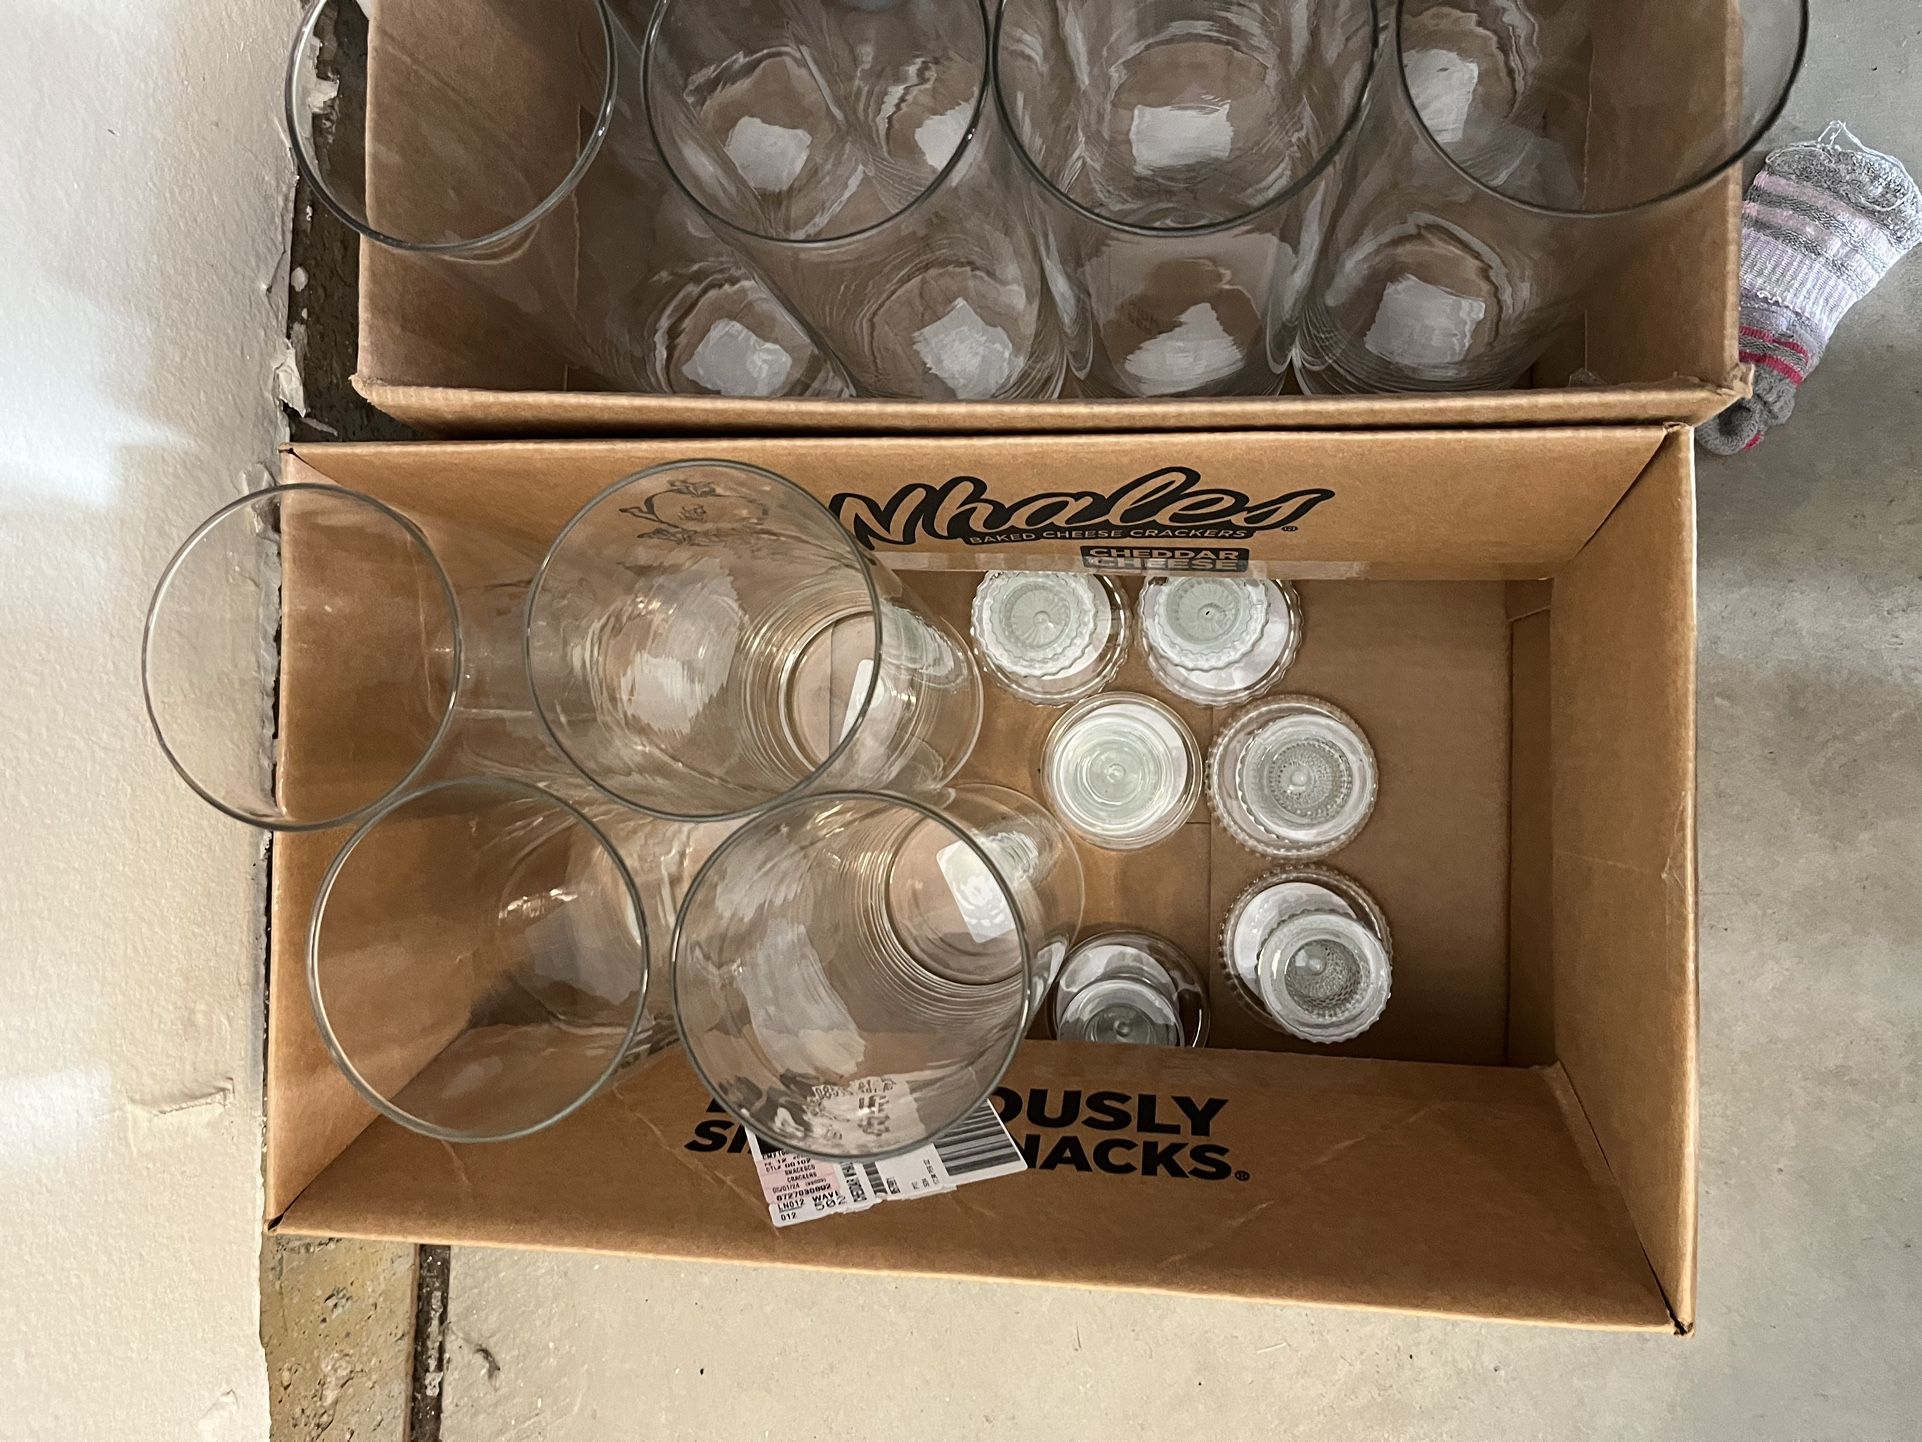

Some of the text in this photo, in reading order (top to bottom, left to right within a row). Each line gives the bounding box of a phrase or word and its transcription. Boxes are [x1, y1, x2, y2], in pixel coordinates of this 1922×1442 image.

[828, 466, 1335, 550] Whales
[969, 528, 1248, 544] BAKED CHEESE CRACKERS
[1090, 548, 1239, 560] CHEDDAR
[1089, 557, 1239, 571] CHEESE
